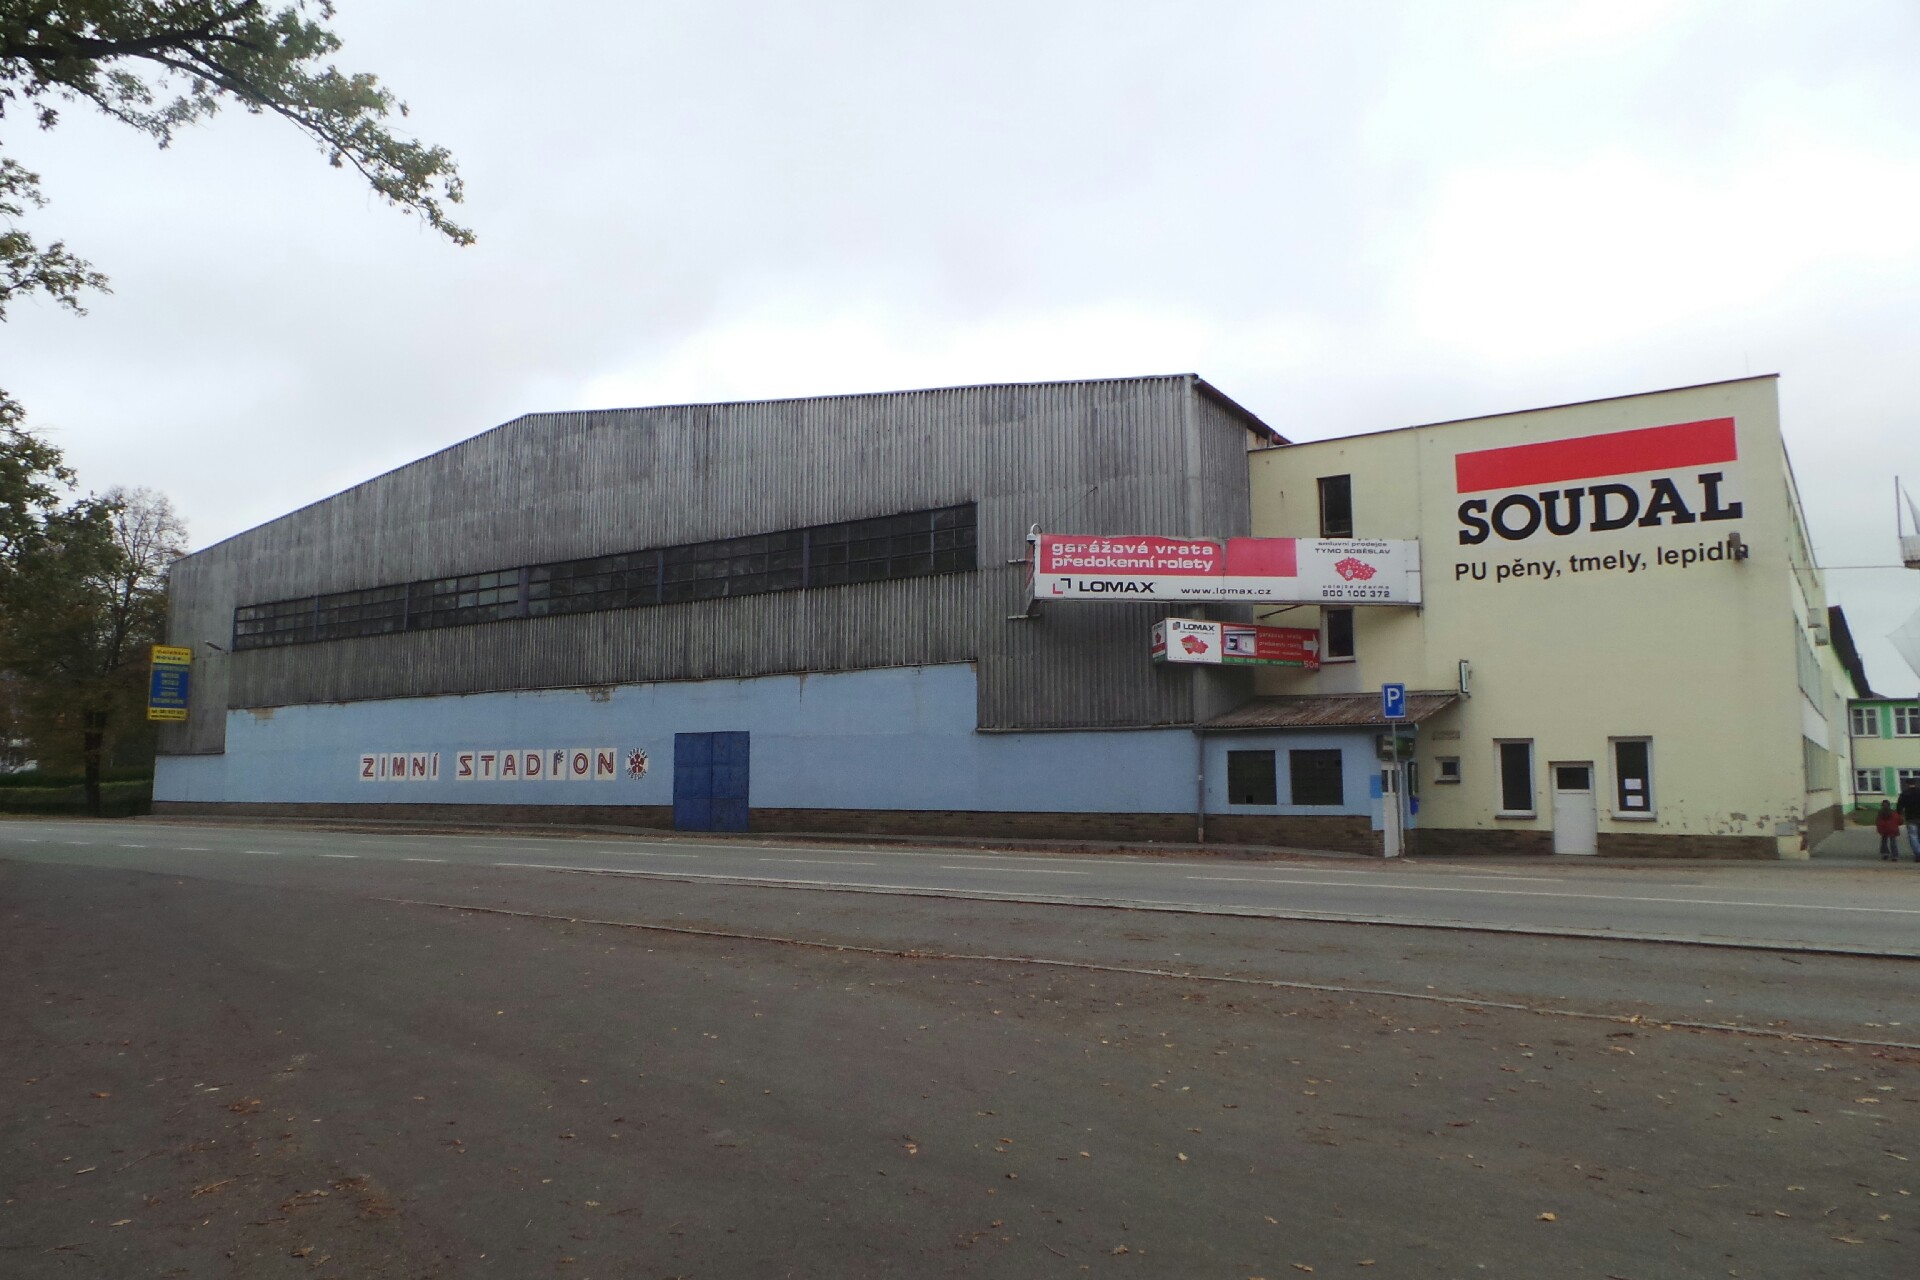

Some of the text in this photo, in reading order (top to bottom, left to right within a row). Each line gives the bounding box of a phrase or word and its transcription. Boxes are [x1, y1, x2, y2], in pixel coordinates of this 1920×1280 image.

[1458, 471, 1743, 545] SOUDAL
[1052, 540, 1213, 555] garážová vrata
[1052, 555, 1214, 572] předokenní rolety
[1455, 561, 1487, 581] PU
[1496, 558, 1561, 583] pěny,
[1569, 550, 1647, 573] tmely,
[1079, 581, 1156, 593] LOMAX
[1181, 587, 1272, 595] www.lomax.cz
[1183, 623, 1216, 632] LOMAX
[1387, 687, 1401, 708] P
[362, 751, 614, 777] ZIMNÍ STADION
